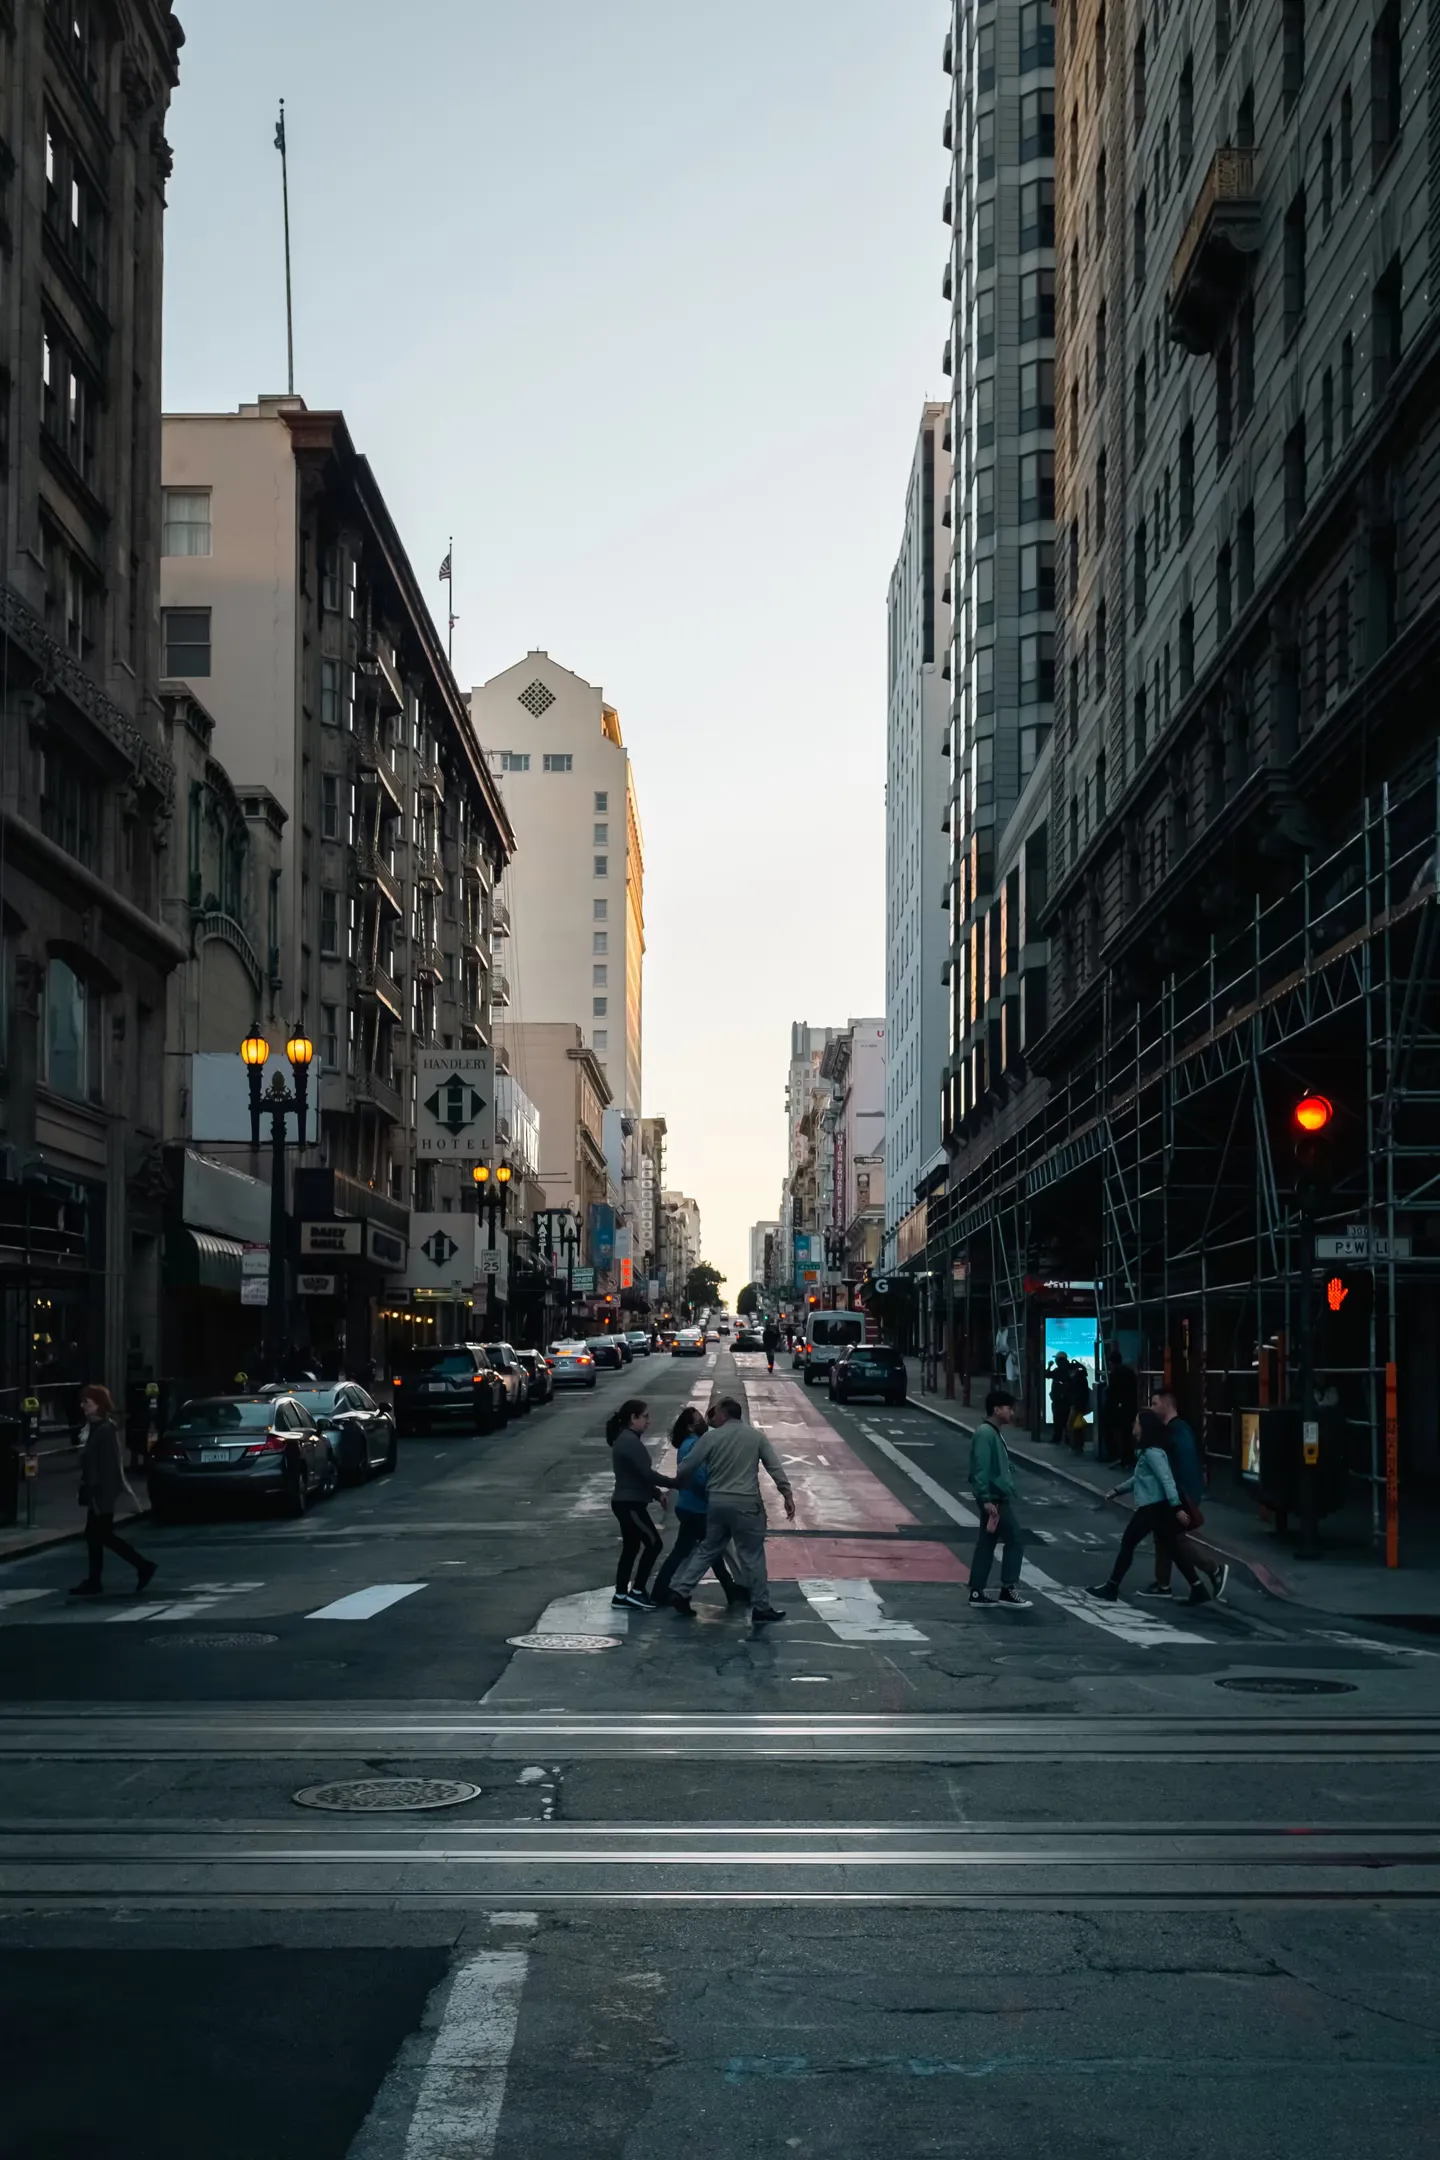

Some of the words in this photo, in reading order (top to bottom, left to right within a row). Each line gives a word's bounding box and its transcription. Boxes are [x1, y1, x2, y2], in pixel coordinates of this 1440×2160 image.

[423, 1059, 488, 1070] HANDLERY
[422, 1139, 489, 1150] HOTEL
[483, 1262, 499, 1272] 25
[874, 1278, 889, 1294] G
